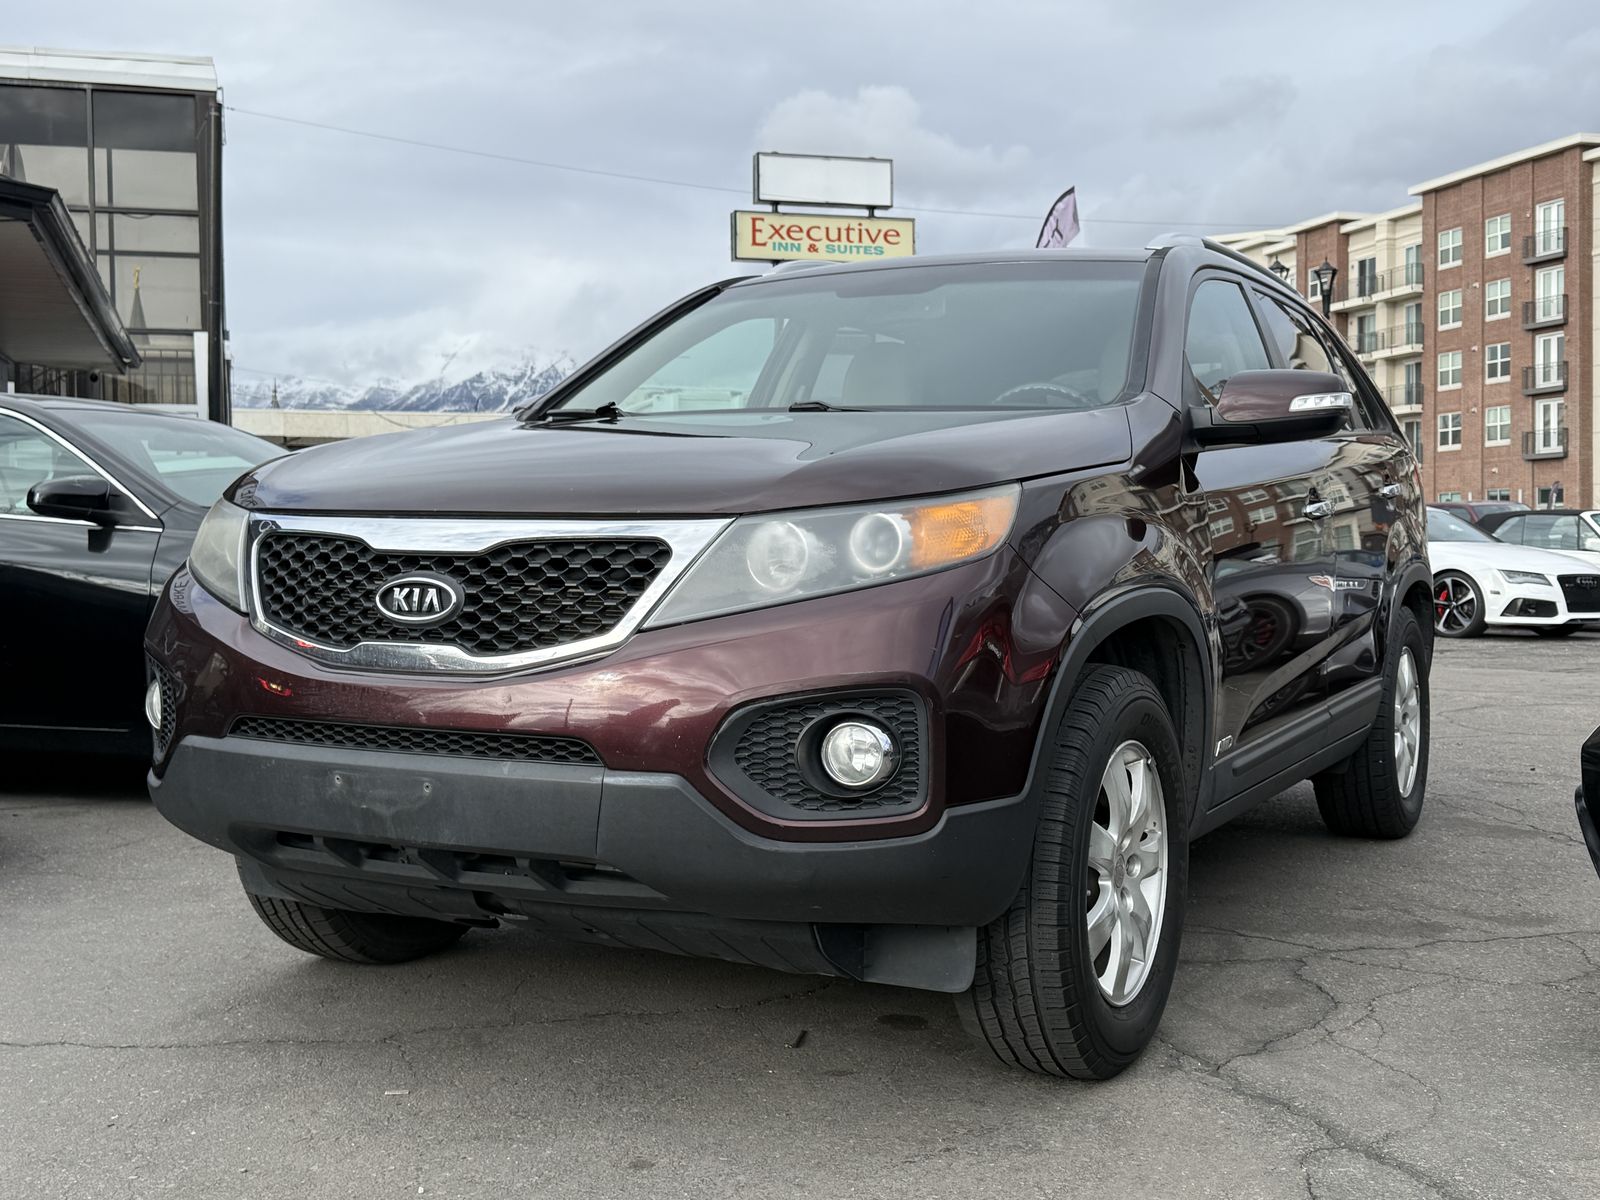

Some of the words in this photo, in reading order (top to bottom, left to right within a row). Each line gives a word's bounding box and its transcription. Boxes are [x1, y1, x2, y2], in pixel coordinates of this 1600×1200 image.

[751, 217, 900, 246] Executive
[772, 241, 800, 252] INN
[808, 243, 819, 253] &
[825, 244, 885, 256] SUITES
[392, 588, 440, 611] KIA
